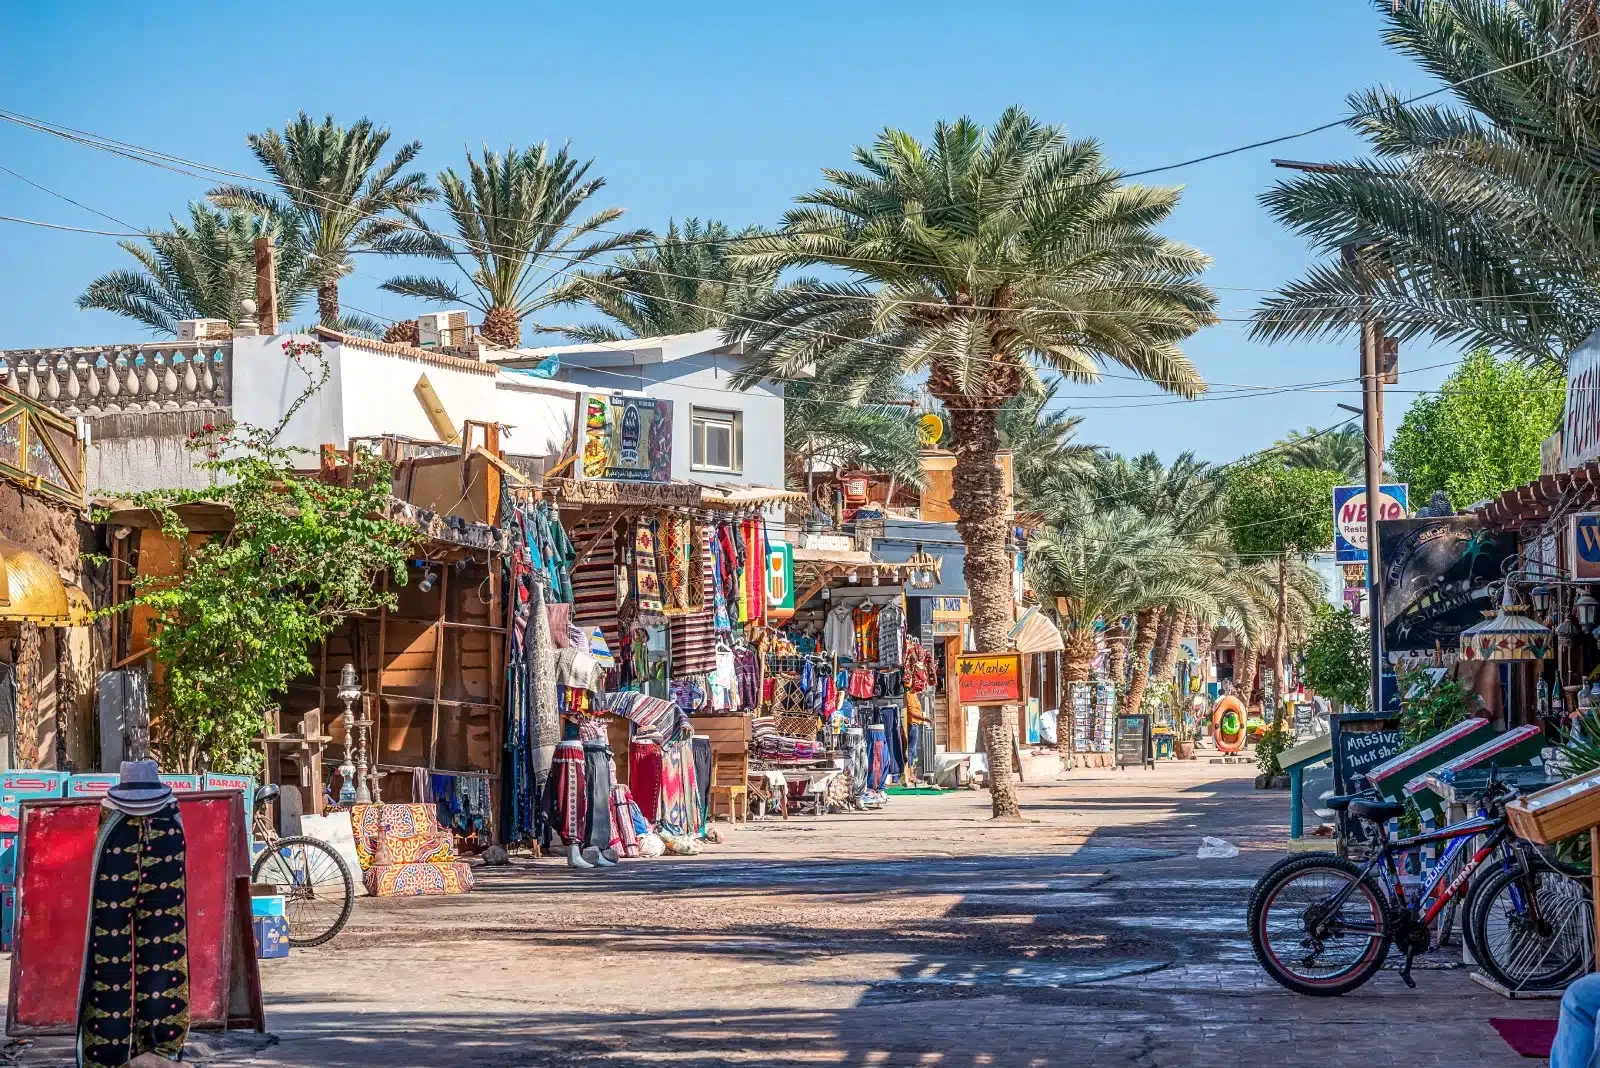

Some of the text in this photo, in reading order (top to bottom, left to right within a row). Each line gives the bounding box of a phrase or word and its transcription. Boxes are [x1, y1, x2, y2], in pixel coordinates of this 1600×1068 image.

[973, 660, 1009, 675] Marley
[161, 781, 192, 789] RAKA
[209, 779, 248, 789] BARAKA
[1444, 857, 1479, 896] TRINX
